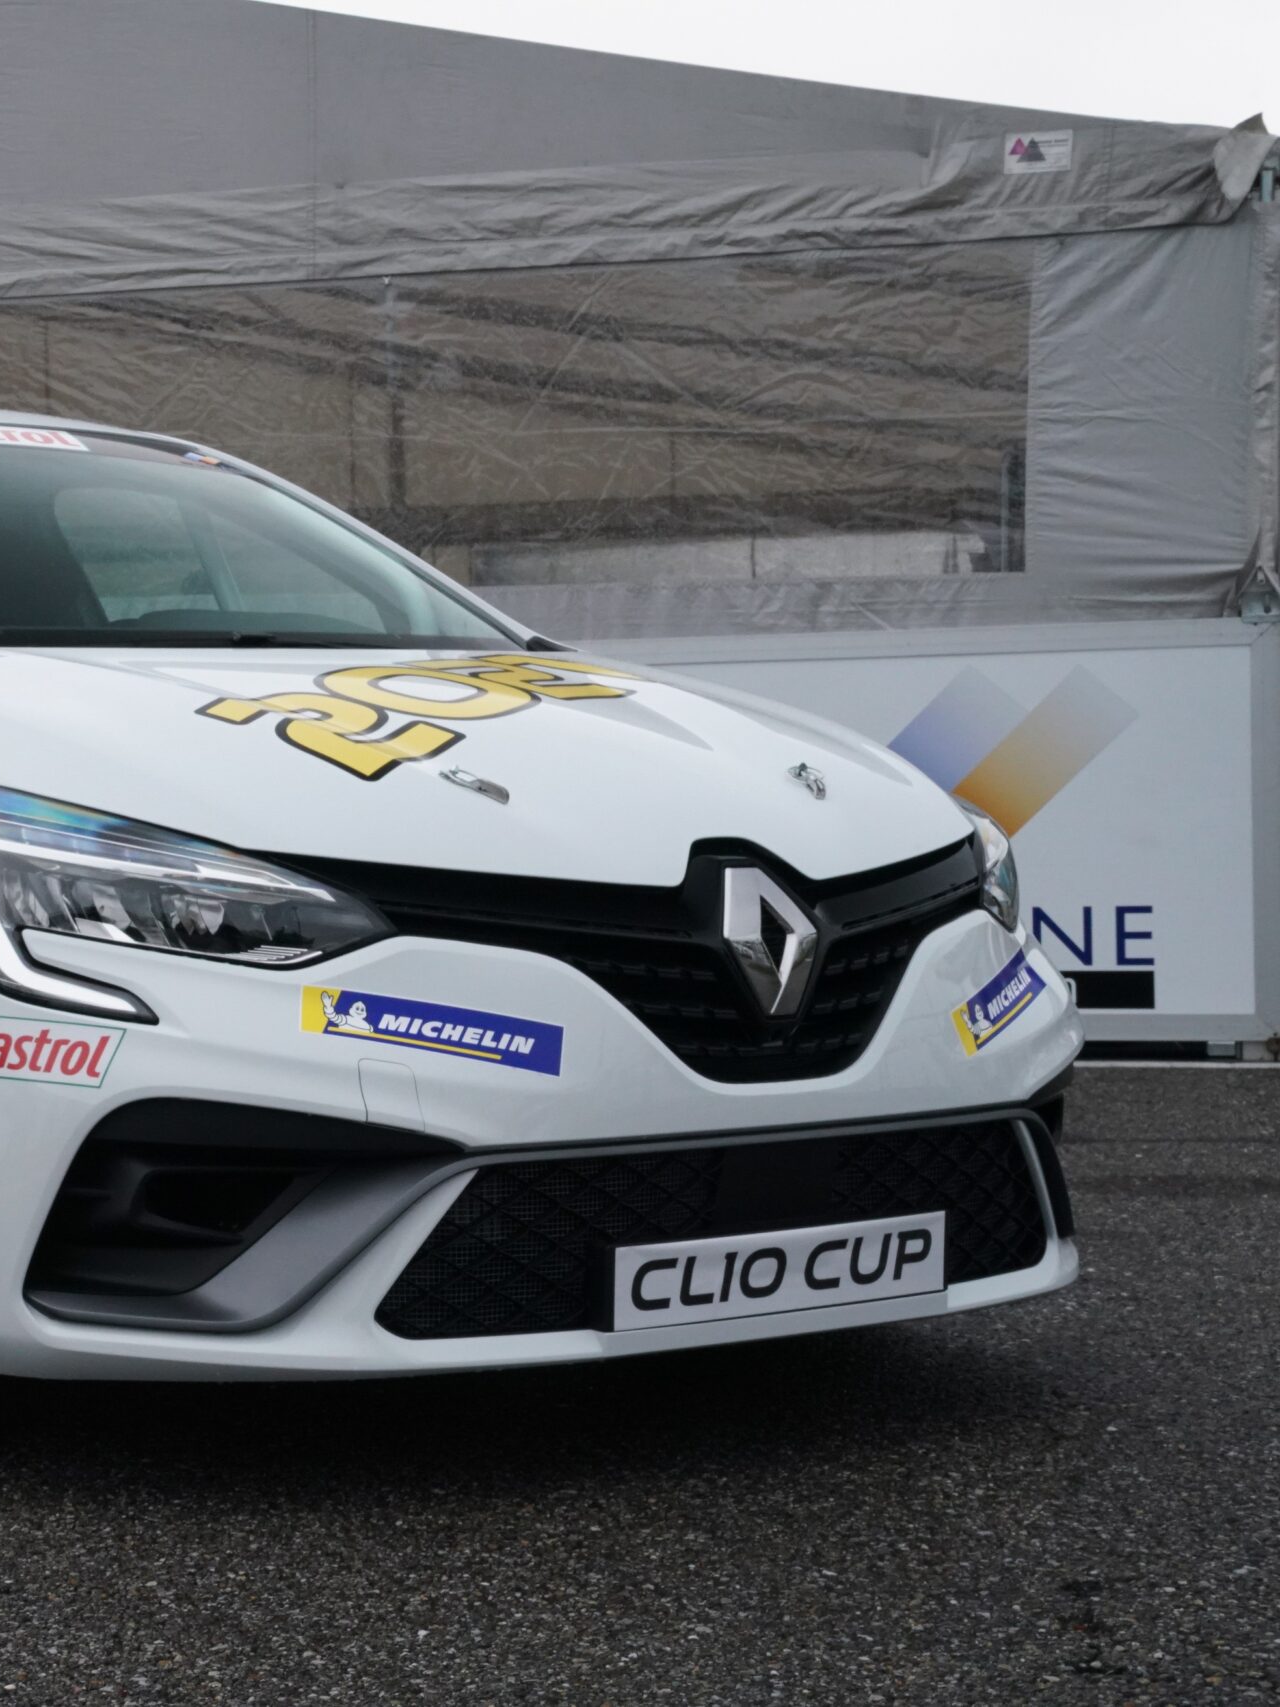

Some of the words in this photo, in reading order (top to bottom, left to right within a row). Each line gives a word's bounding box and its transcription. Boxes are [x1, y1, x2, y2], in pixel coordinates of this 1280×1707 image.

[986, 966, 1032, 1022] MICHELIN
[377, 1013, 536, 1055] MICHELIN
[631, 1246, 788, 1311] CLIO
[804, 1228, 933, 1291] CUP
